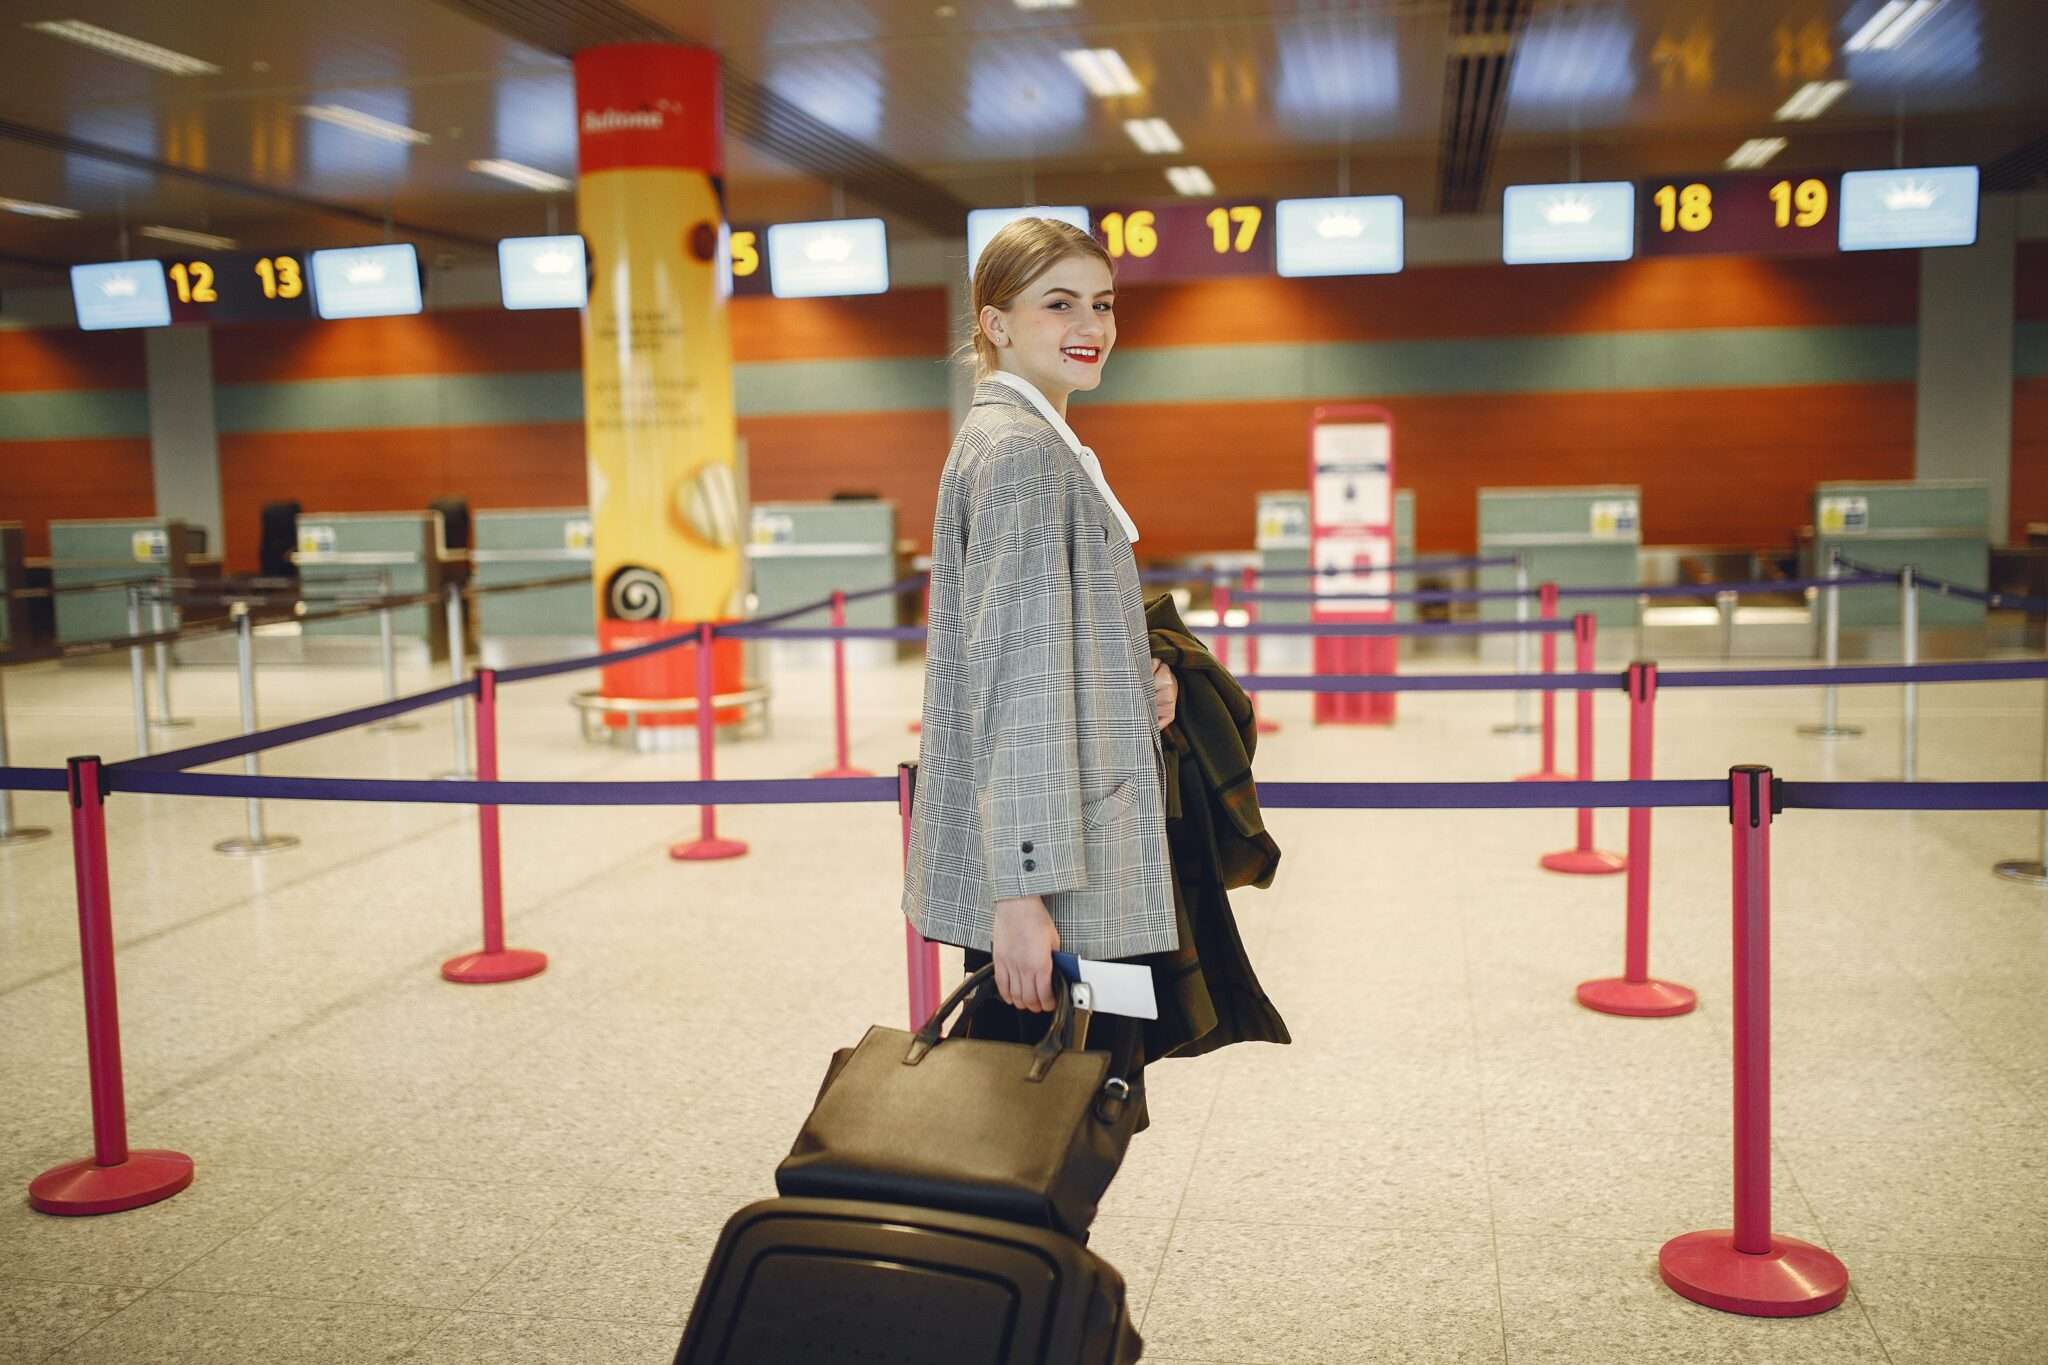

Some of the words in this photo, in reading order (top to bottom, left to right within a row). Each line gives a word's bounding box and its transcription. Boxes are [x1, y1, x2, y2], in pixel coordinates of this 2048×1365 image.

[1654, 183, 1713, 233] 18
[1769, 179, 1828, 228] 19
[730, 231, 759, 277] 5
[1100, 210, 1158, 258] 16
[1206, 206, 1262, 253] 17
[169, 261, 218, 303] 12
[254, 256, 303, 299] 13
